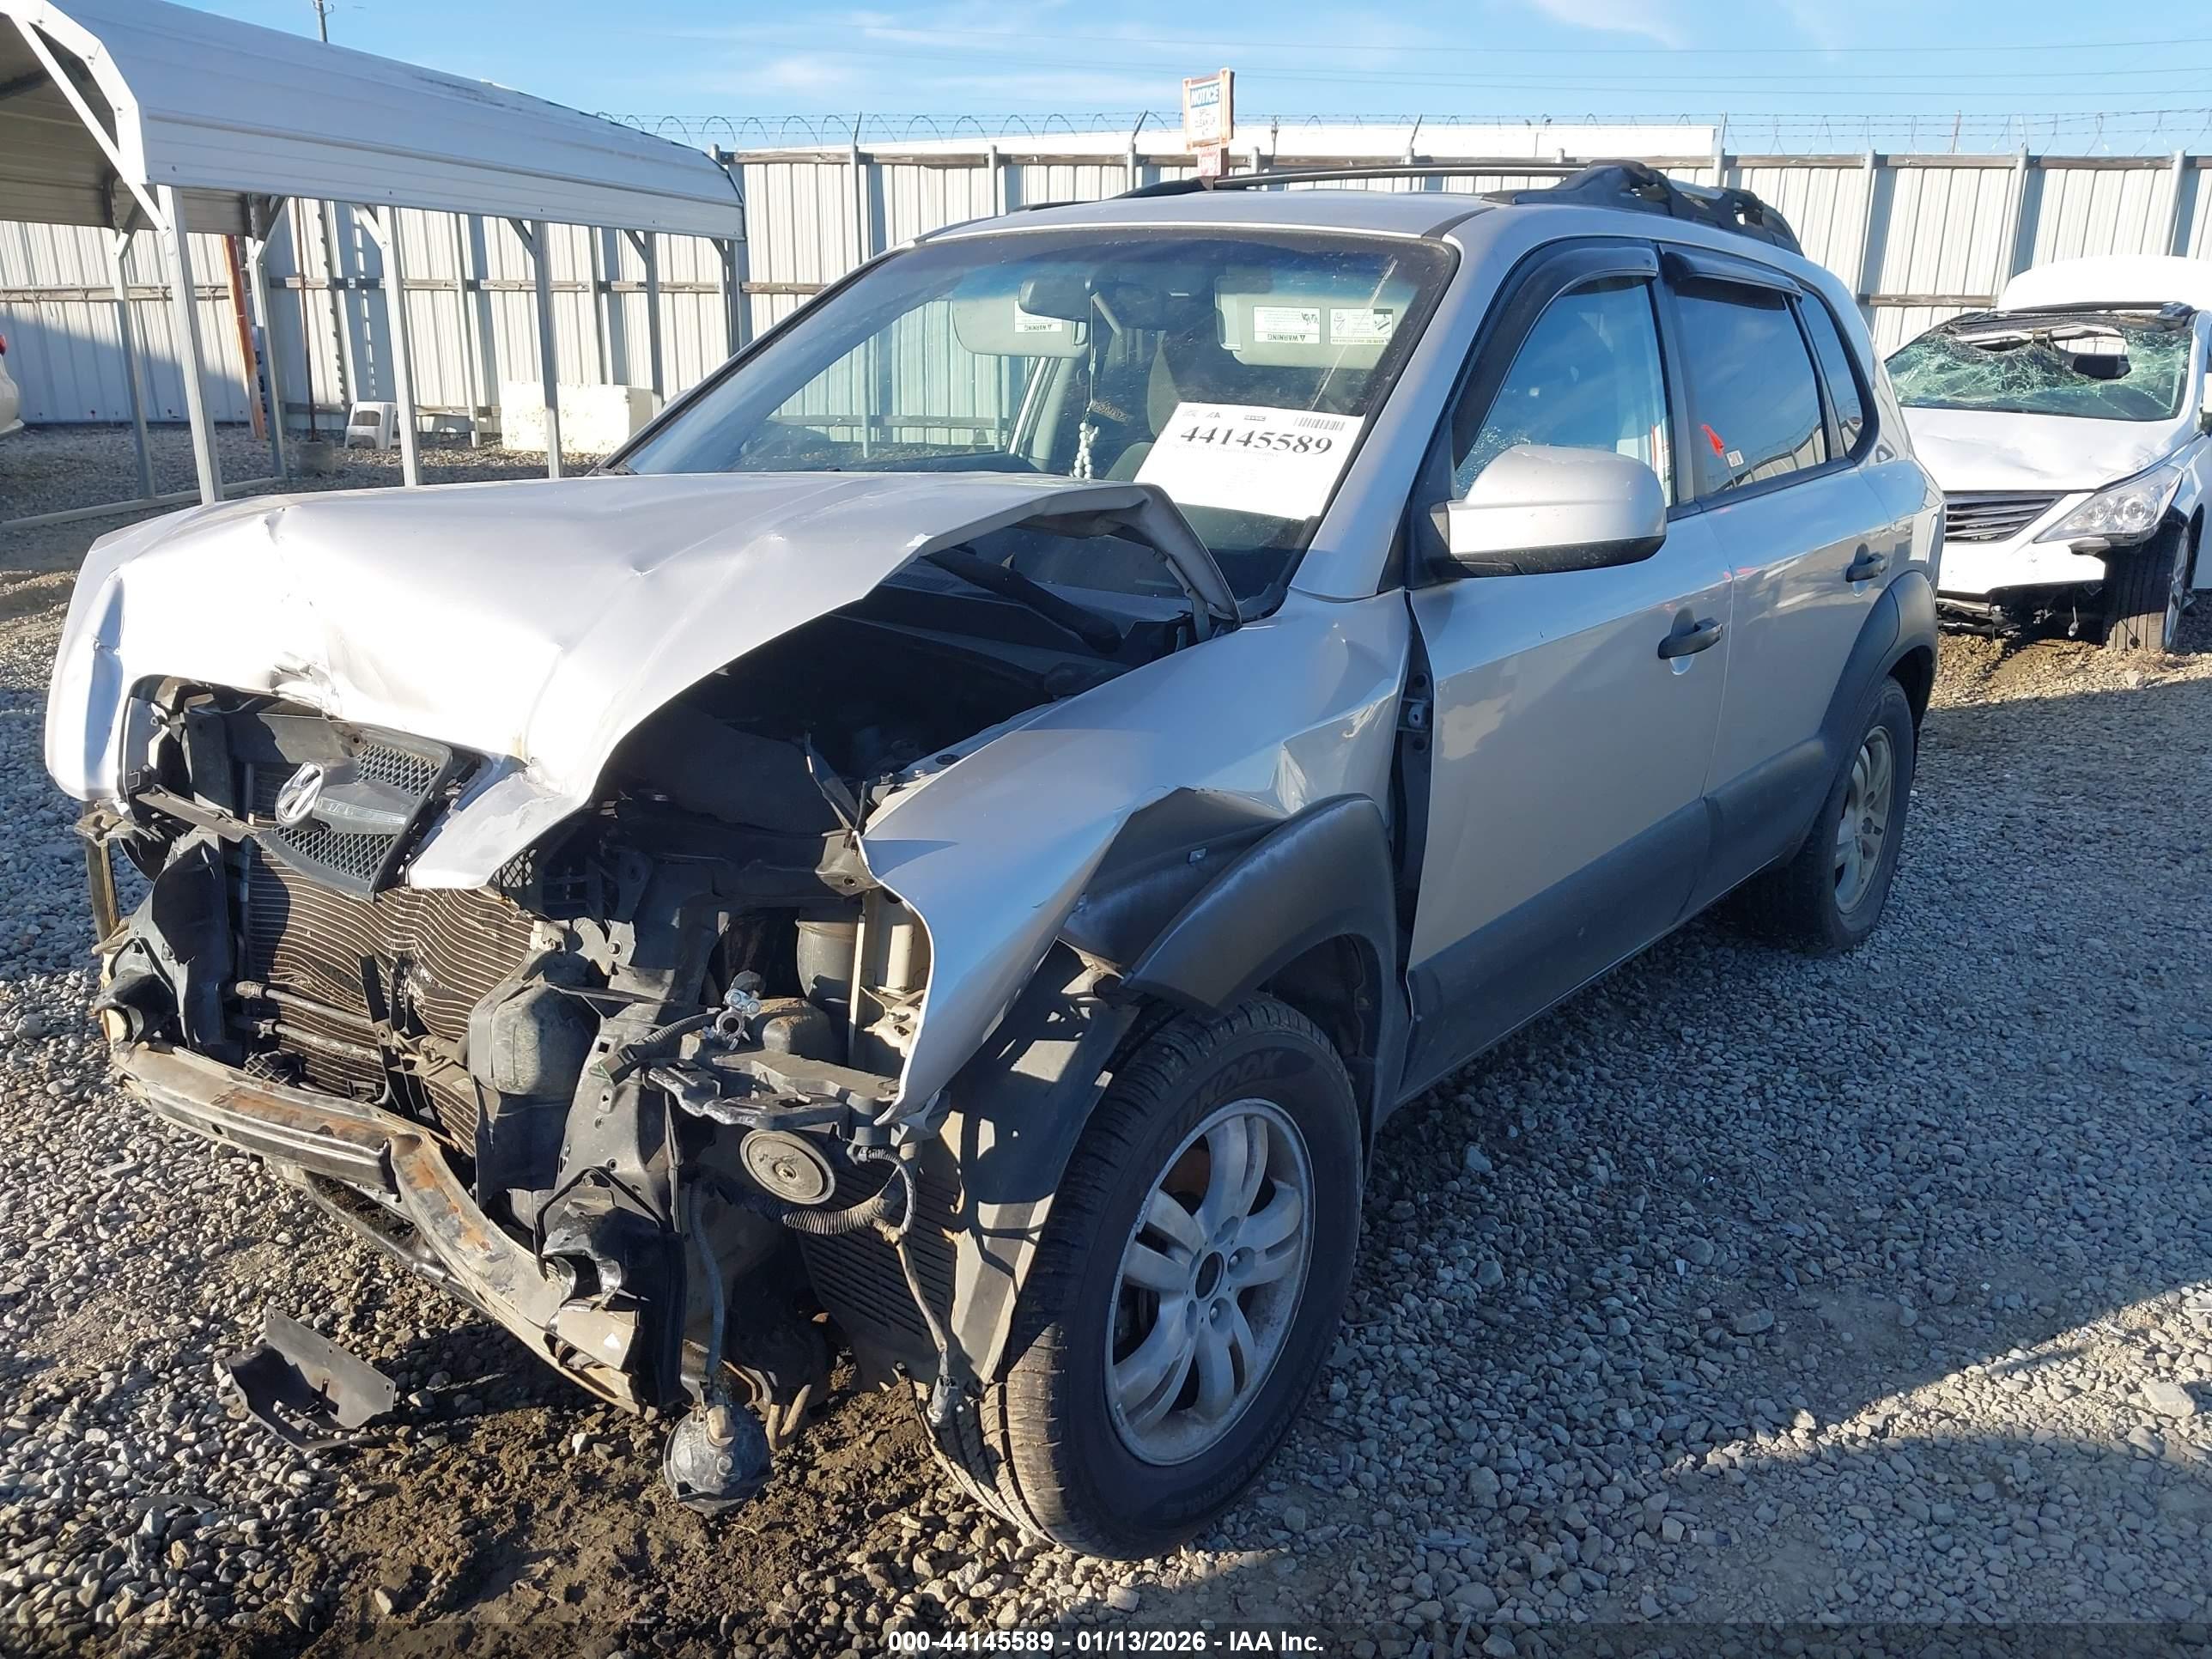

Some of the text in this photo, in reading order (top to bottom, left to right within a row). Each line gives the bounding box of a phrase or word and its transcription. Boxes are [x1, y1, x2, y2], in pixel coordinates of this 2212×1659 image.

[1190, 85, 1220, 106] NOTICE
[1267, 333, 1298, 342] WARNING
[1180, 426, 1333, 455] 44145589
